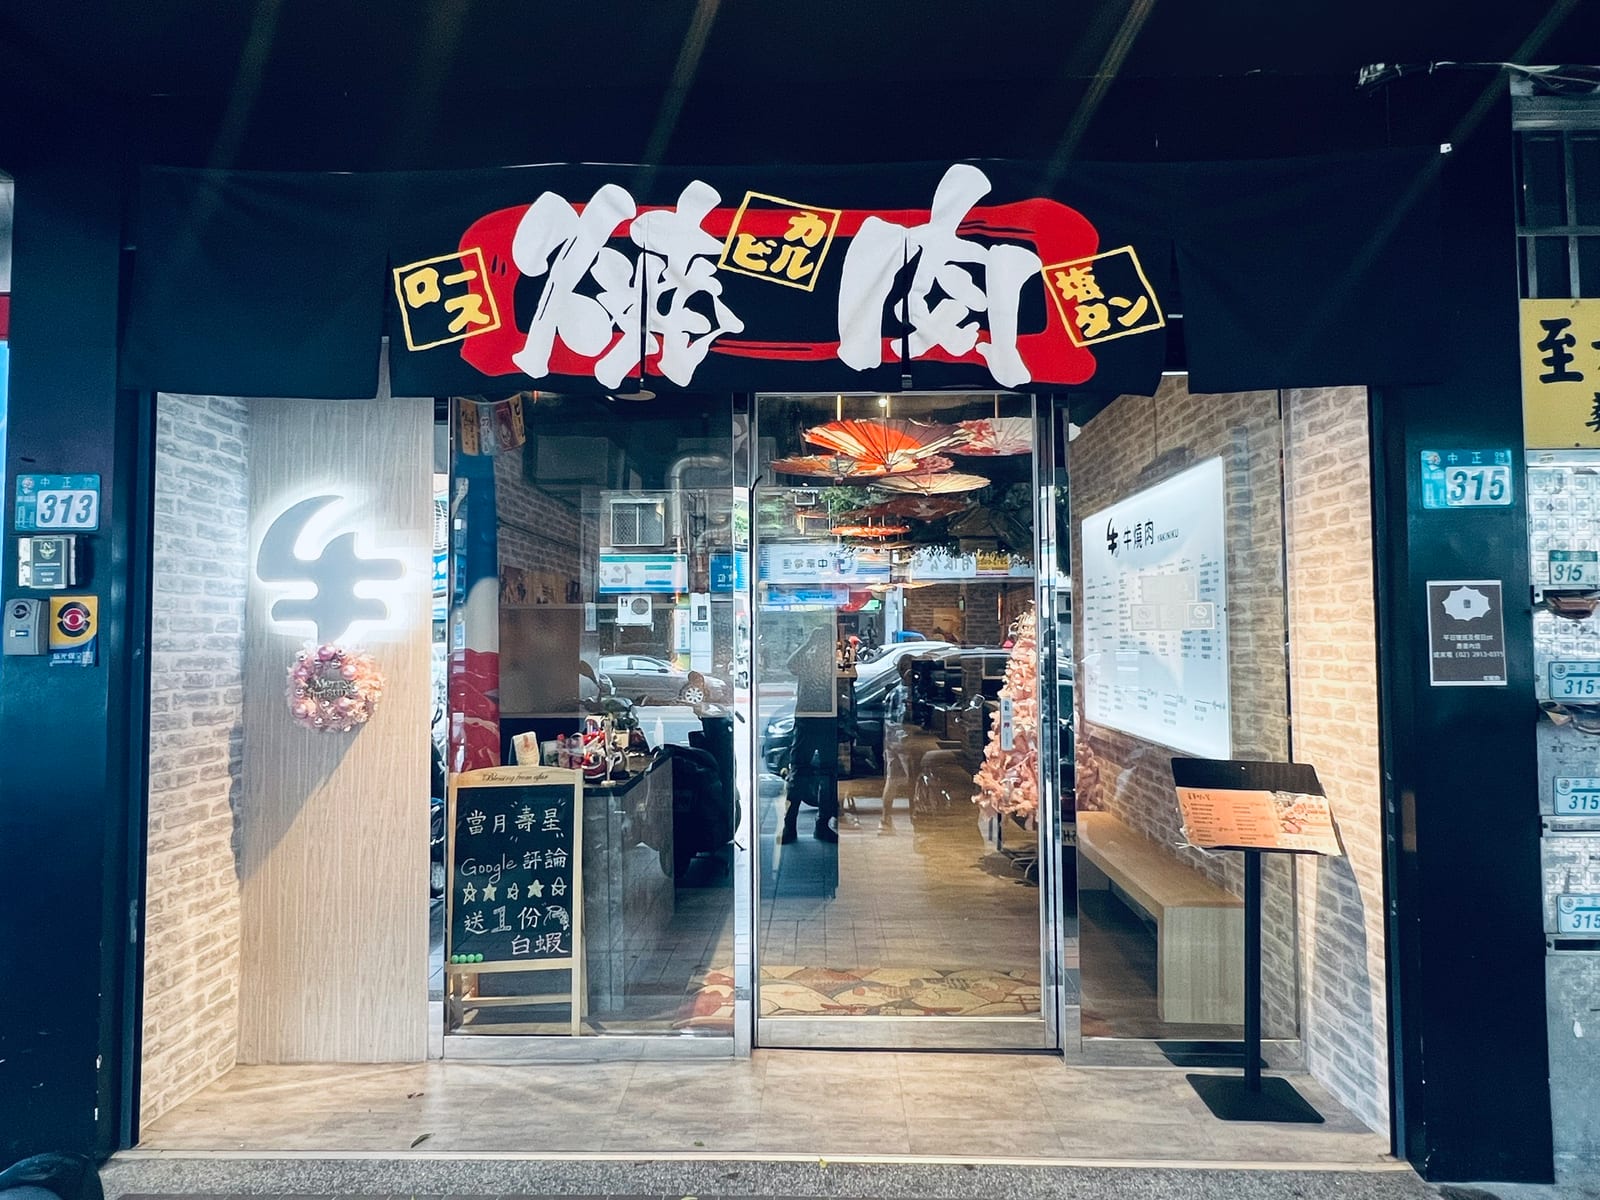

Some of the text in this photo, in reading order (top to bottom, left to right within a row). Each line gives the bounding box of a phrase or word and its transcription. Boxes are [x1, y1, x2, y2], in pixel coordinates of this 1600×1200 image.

[1537, 318, 1600, 384] 至
[1450, 470, 1505, 501] 315
[41, 494, 93, 523] 313
[1554, 564, 1583, 581] 315
[1568, 795, 1600, 810] 315
[466, 805, 563, 836] 當月壽星
[461, 847, 569, 884] Google 評論
[511, 931, 568, 955] 白蝦
